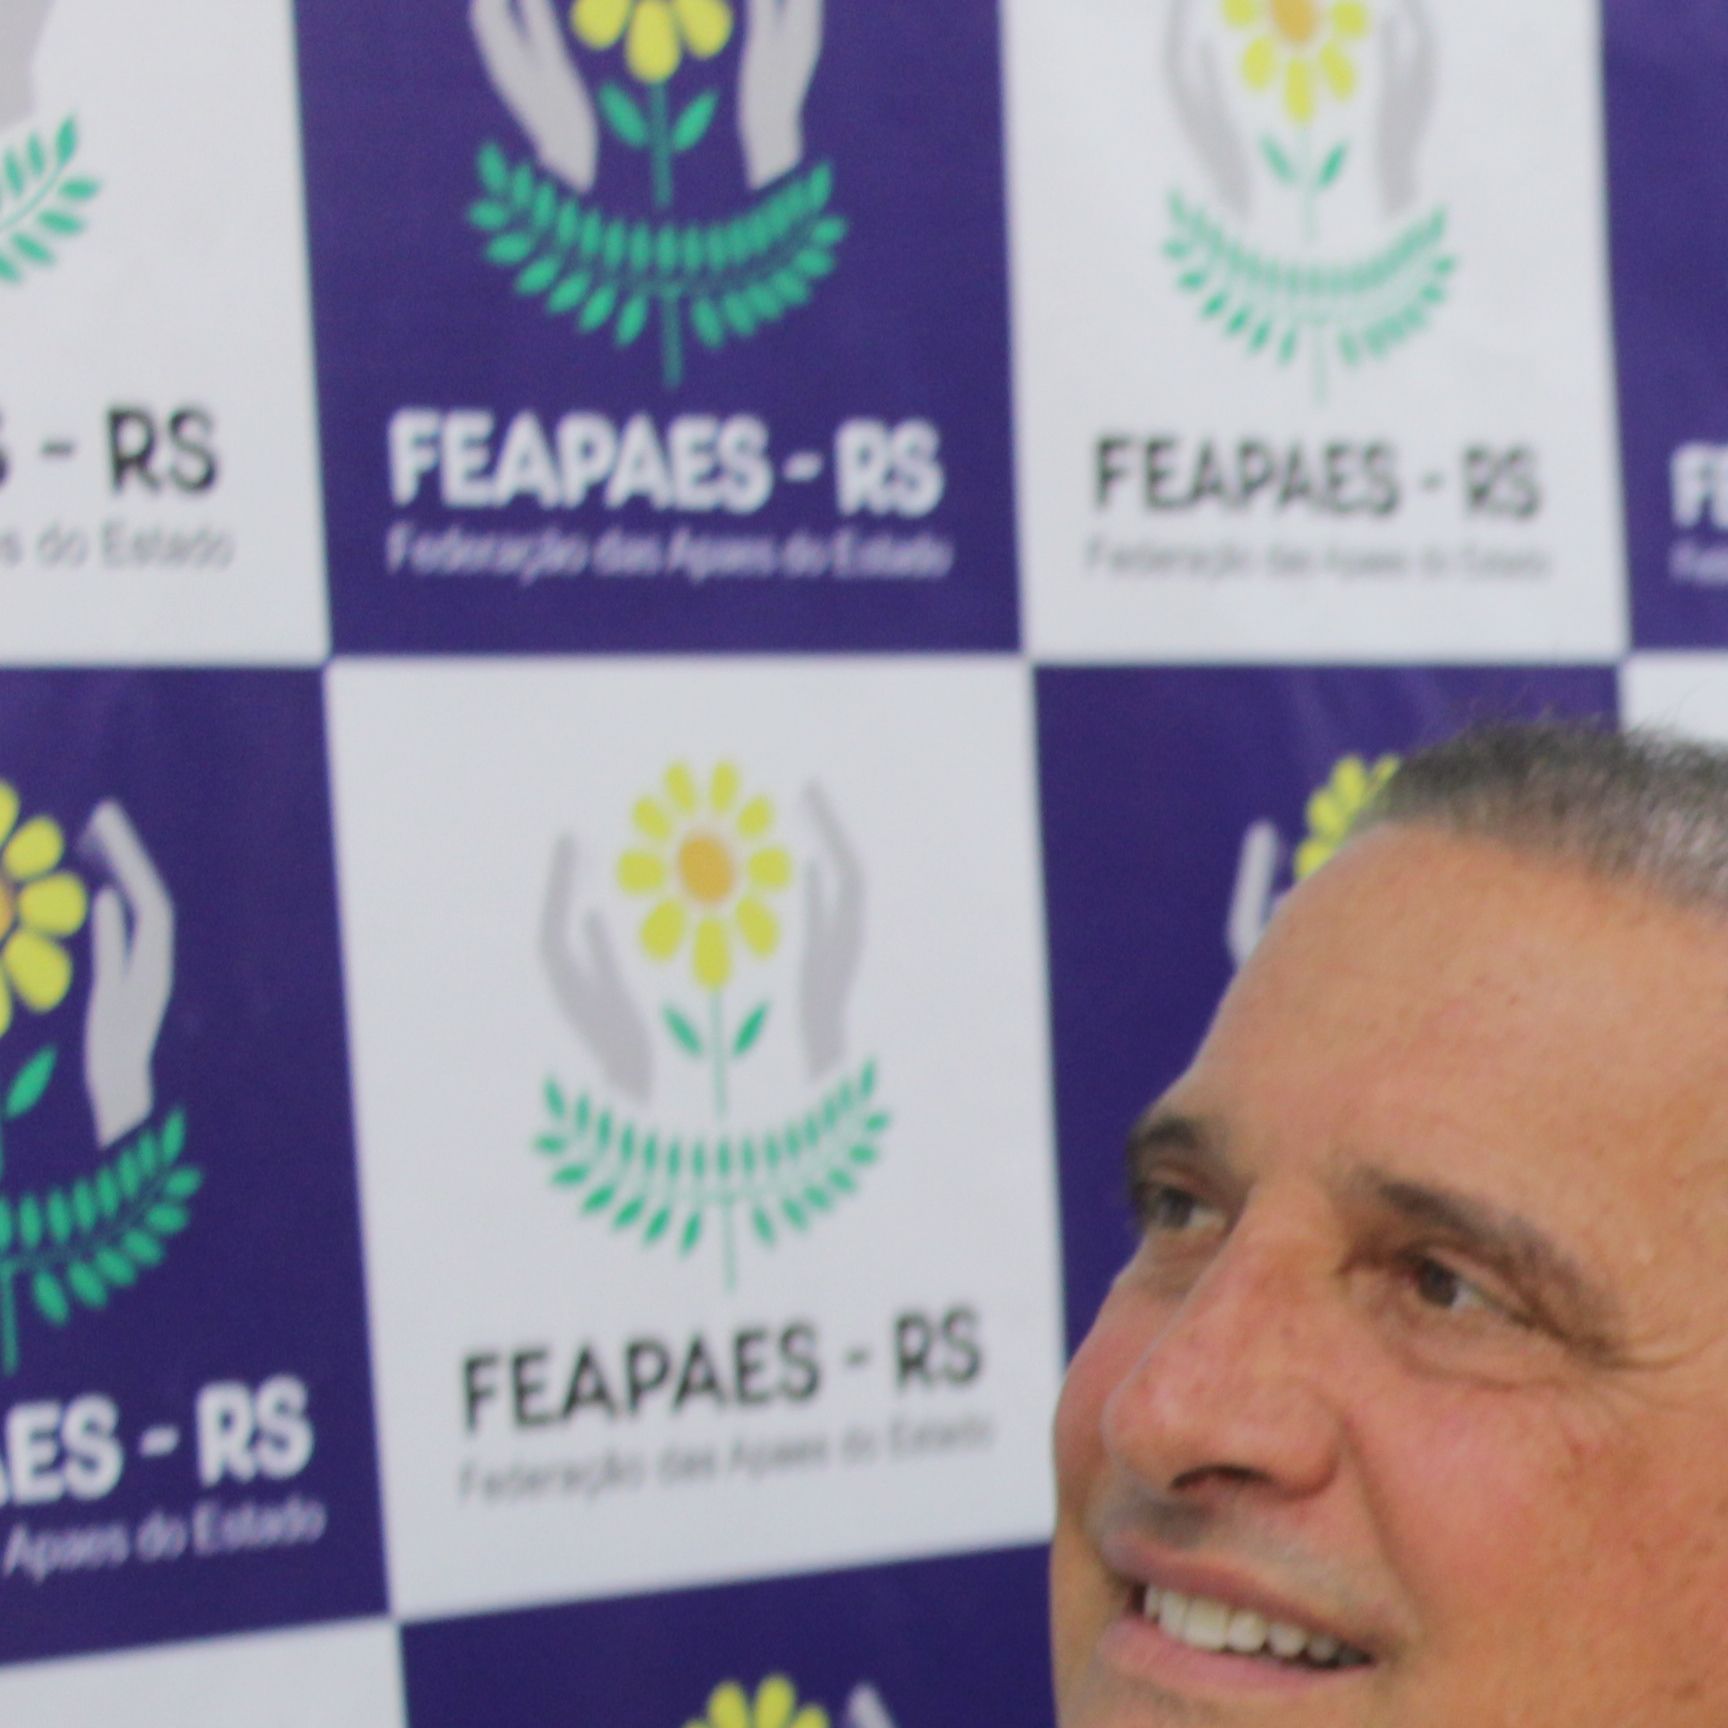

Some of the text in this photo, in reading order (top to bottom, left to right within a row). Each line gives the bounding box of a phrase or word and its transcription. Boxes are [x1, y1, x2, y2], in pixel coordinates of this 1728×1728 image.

[107, 406, 219, 496] RS
[387, 408, 774, 516] FEAPAES
[834, 416, 945, 518] RS
[1093, 434, 1404, 518] FEAPAES
[1462, 443, 1543, 520] RS
[37, 522, 89, 568] do
[102, 517, 236, 569] Estado
[463, 1320, 822, 1436] FEAPAES
[893, 1306, 984, 1392] RS
[0, 1393, 124, 1508] ES
[195, 1373, 315, 1489] RS
[192, 1495, 328, 1557] Estado
